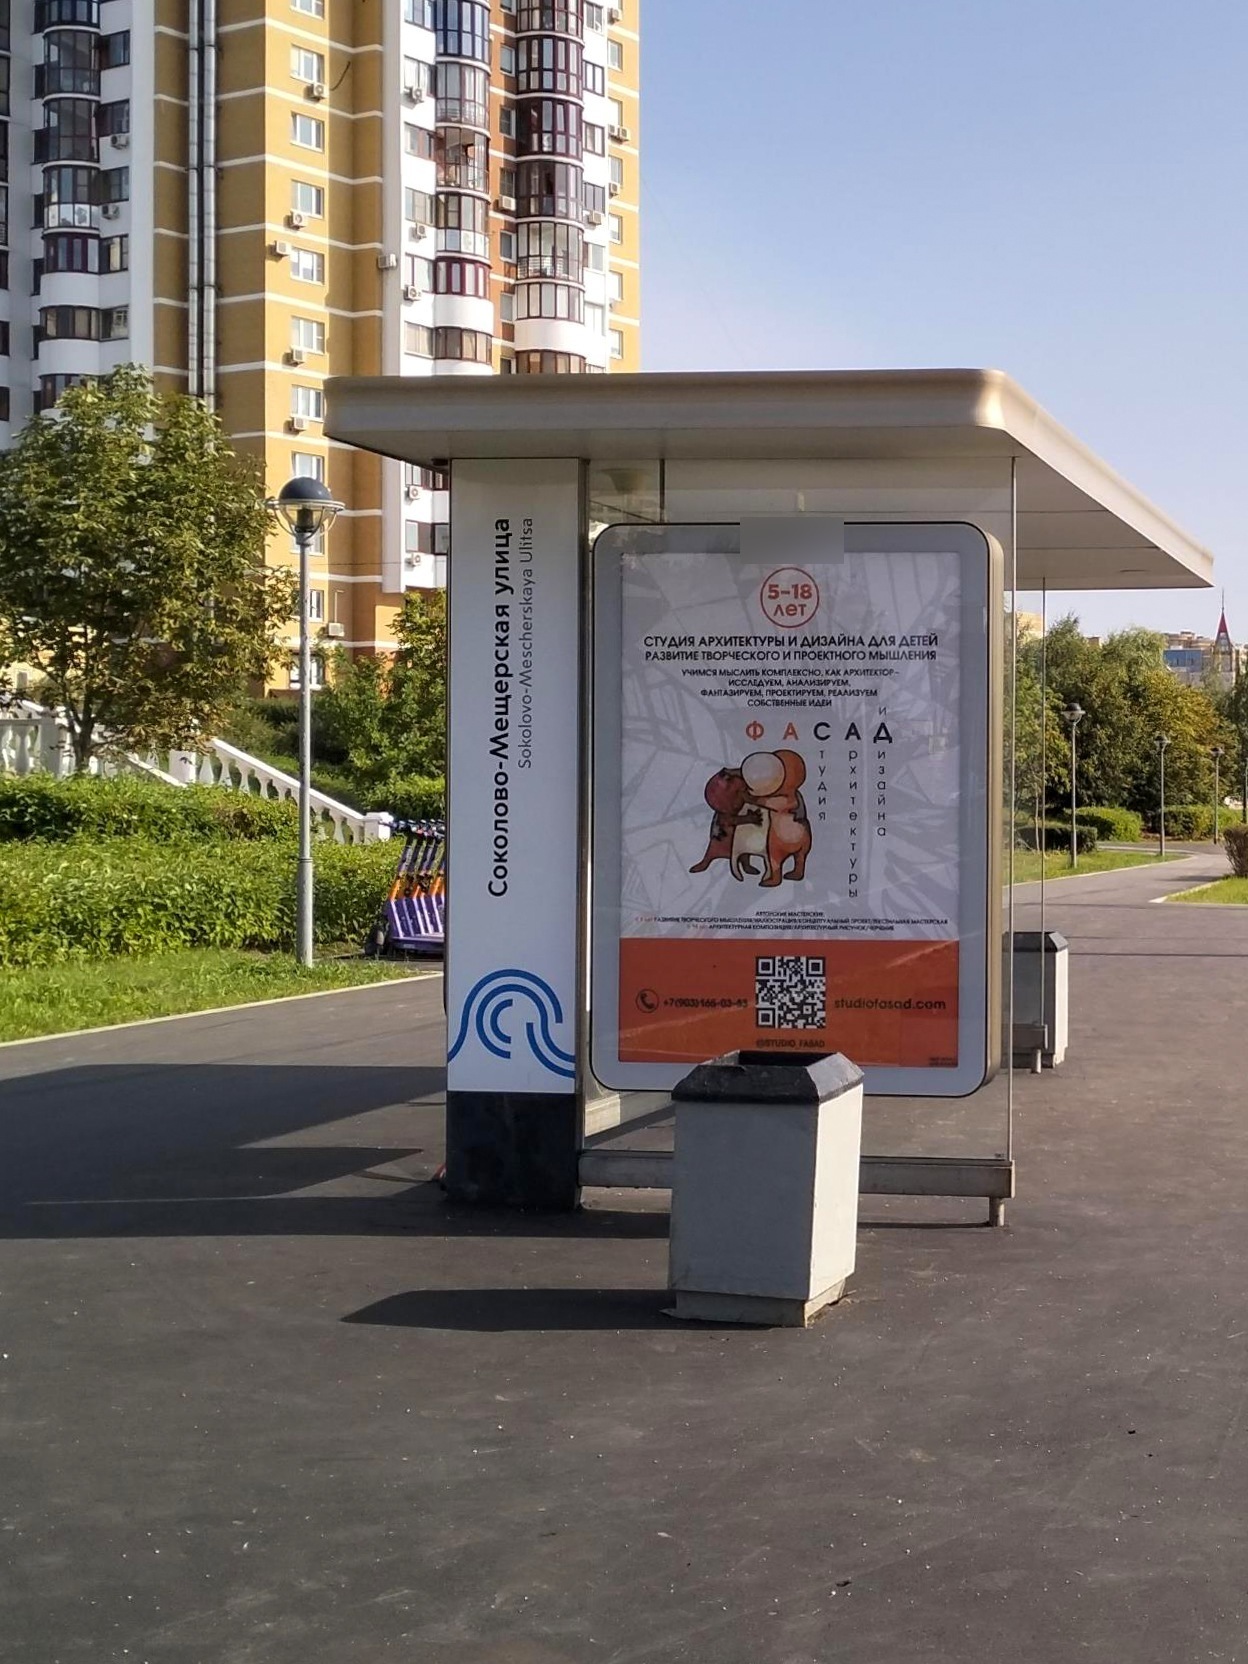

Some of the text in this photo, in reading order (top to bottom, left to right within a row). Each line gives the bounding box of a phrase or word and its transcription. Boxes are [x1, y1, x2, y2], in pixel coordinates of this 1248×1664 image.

[767, 583, 813, 600] 5-18
[773, 603, 807, 617] лет
[518, 518, 536, 770] Sokolovo-Mescherskaya Ulitsa
[643, 633, 938, 648] СТУДИЯ АРХИТЕКТУРЫ И ДИЗАЙНА ДЛЯ ДЕТЕЙ
[645, 651, 937, 661] РАЗВИТИЕ ТВОРЧЕСКОГО И ПРОЕКТНОГО МЫШЛЕНИЯ
[682, 669, 717, 677] УЧИМСЯ
[719, 669, 760, 677] МЫСЛИТЬ
[825, 668, 841, 677] КАК
[728, 679, 784, 687] ИССЛЕДУЕМ,
[701, 689, 764, 697] ФАНТАЗИРУЕМ,
[828, 689, 878, 697] РЕАЛИЗУЕМ
[488, 518, 514, 898] Соколово-Мещерская улица
[747, 699, 807, 707] СОБСТВЕННЫЕ
[834, 997, 946, 1010] studiofasad.com
